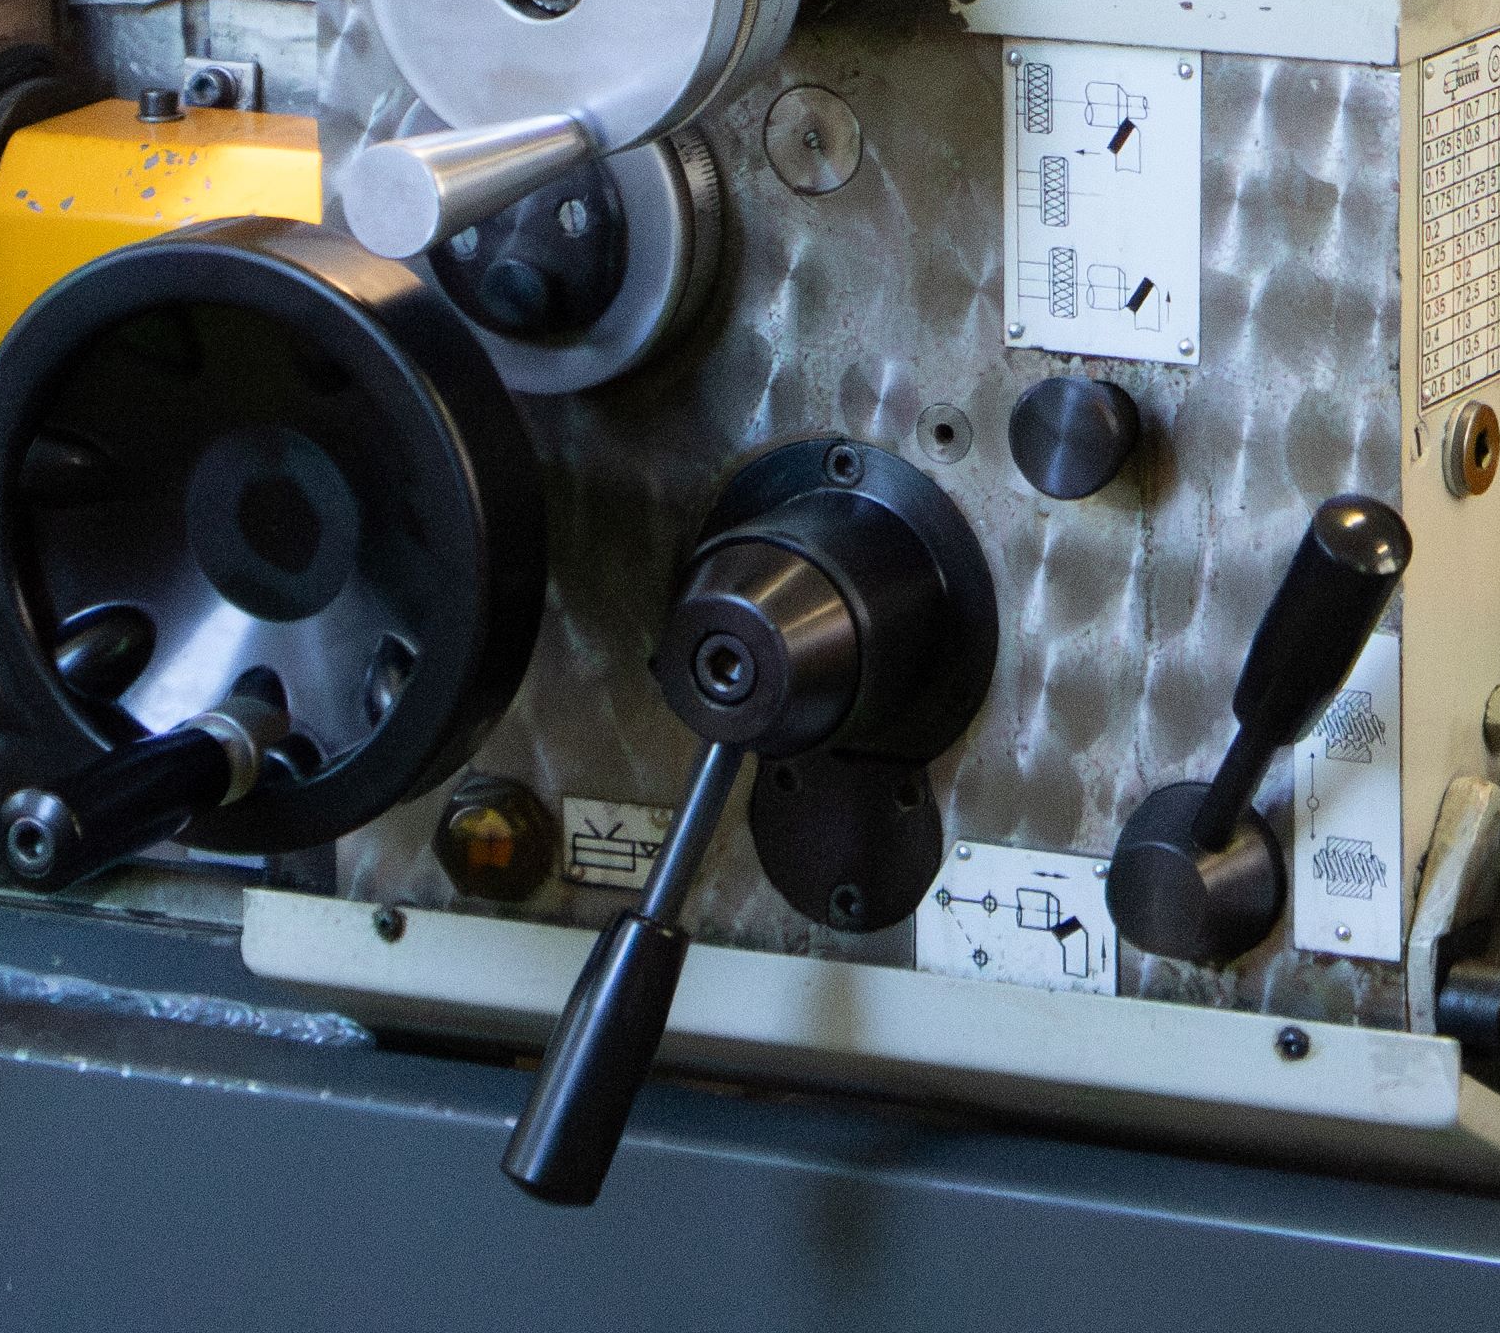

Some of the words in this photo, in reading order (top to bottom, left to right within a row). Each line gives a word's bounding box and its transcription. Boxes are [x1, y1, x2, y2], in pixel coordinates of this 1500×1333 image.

[1426, 115, 1439, 136] 0,1
[1466, 99, 1480, 120] 0,7
[1425, 137, 1452, 162] 0,125
[1466, 125, 1480, 146] 0,8
[1425, 166, 1446, 190] 0,15
[1425, 190, 1452, 216] 0,175
[1467, 175, 1485, 200] 1,25
[1425, 221, 1440, 242] 0,2
[1467, 204, 1480, 225] 1,5
[1425, 245, 1446, 269] 0,25
[1467, 227, 1485, 251] 1,75
[1425, 274, 1440, 295] 0,3
[1466, 282, 1480, 303] 2,5
[1425, 327, 1440, 349] 0,4
[1425, 353, 1440, 375] 0,5
[1466, 334, 1480, 356] 3,5
[1431, 376, 1446, 398] 0,6
